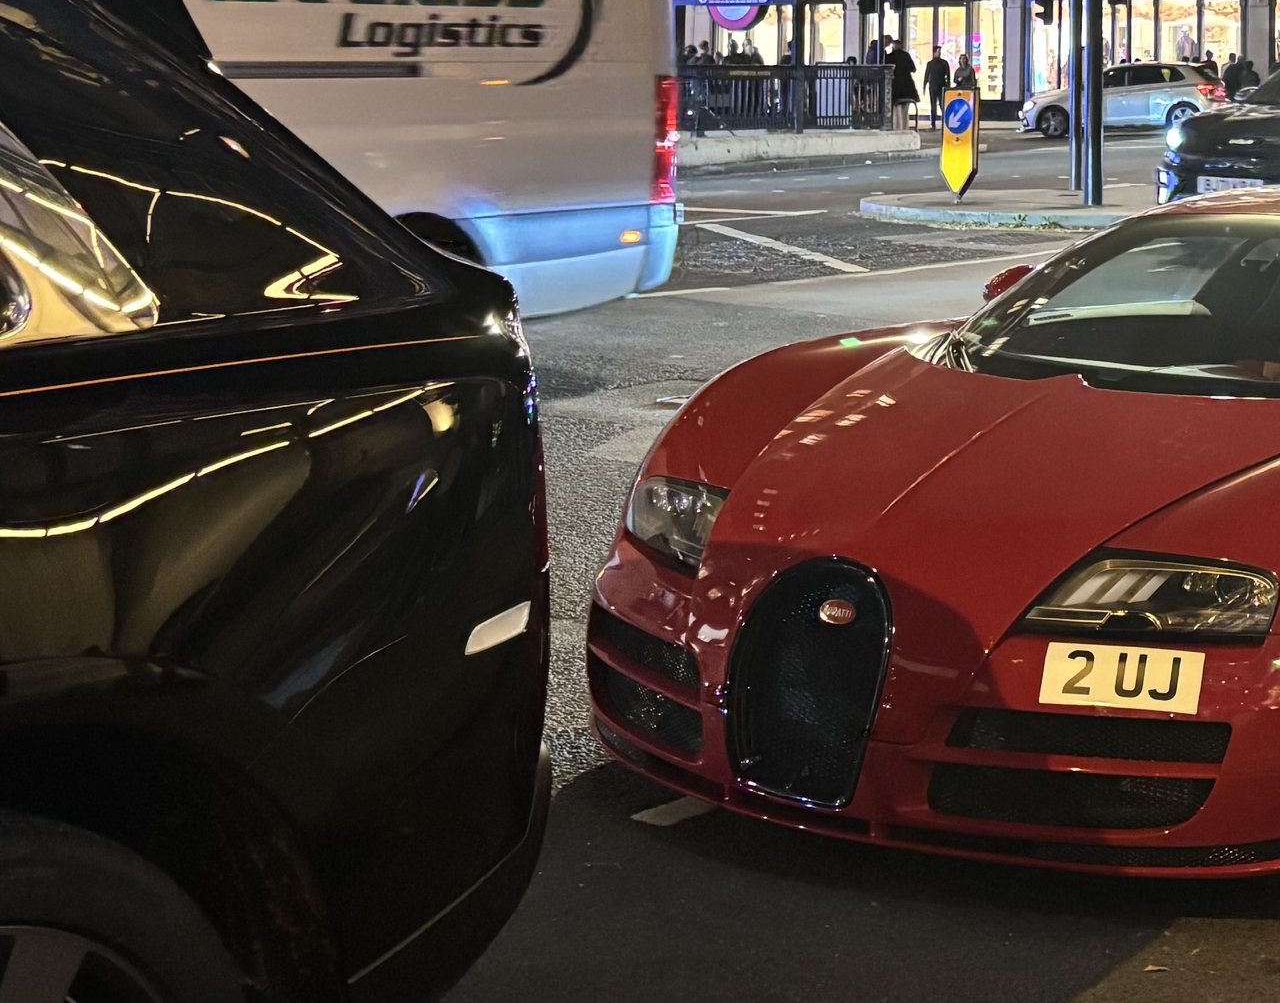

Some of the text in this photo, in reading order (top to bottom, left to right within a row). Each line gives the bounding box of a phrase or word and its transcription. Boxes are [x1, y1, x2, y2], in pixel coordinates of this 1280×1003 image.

[339, 12, 546, 58] Logistics
[1062, 650, 1182, 701] 2 UJ
